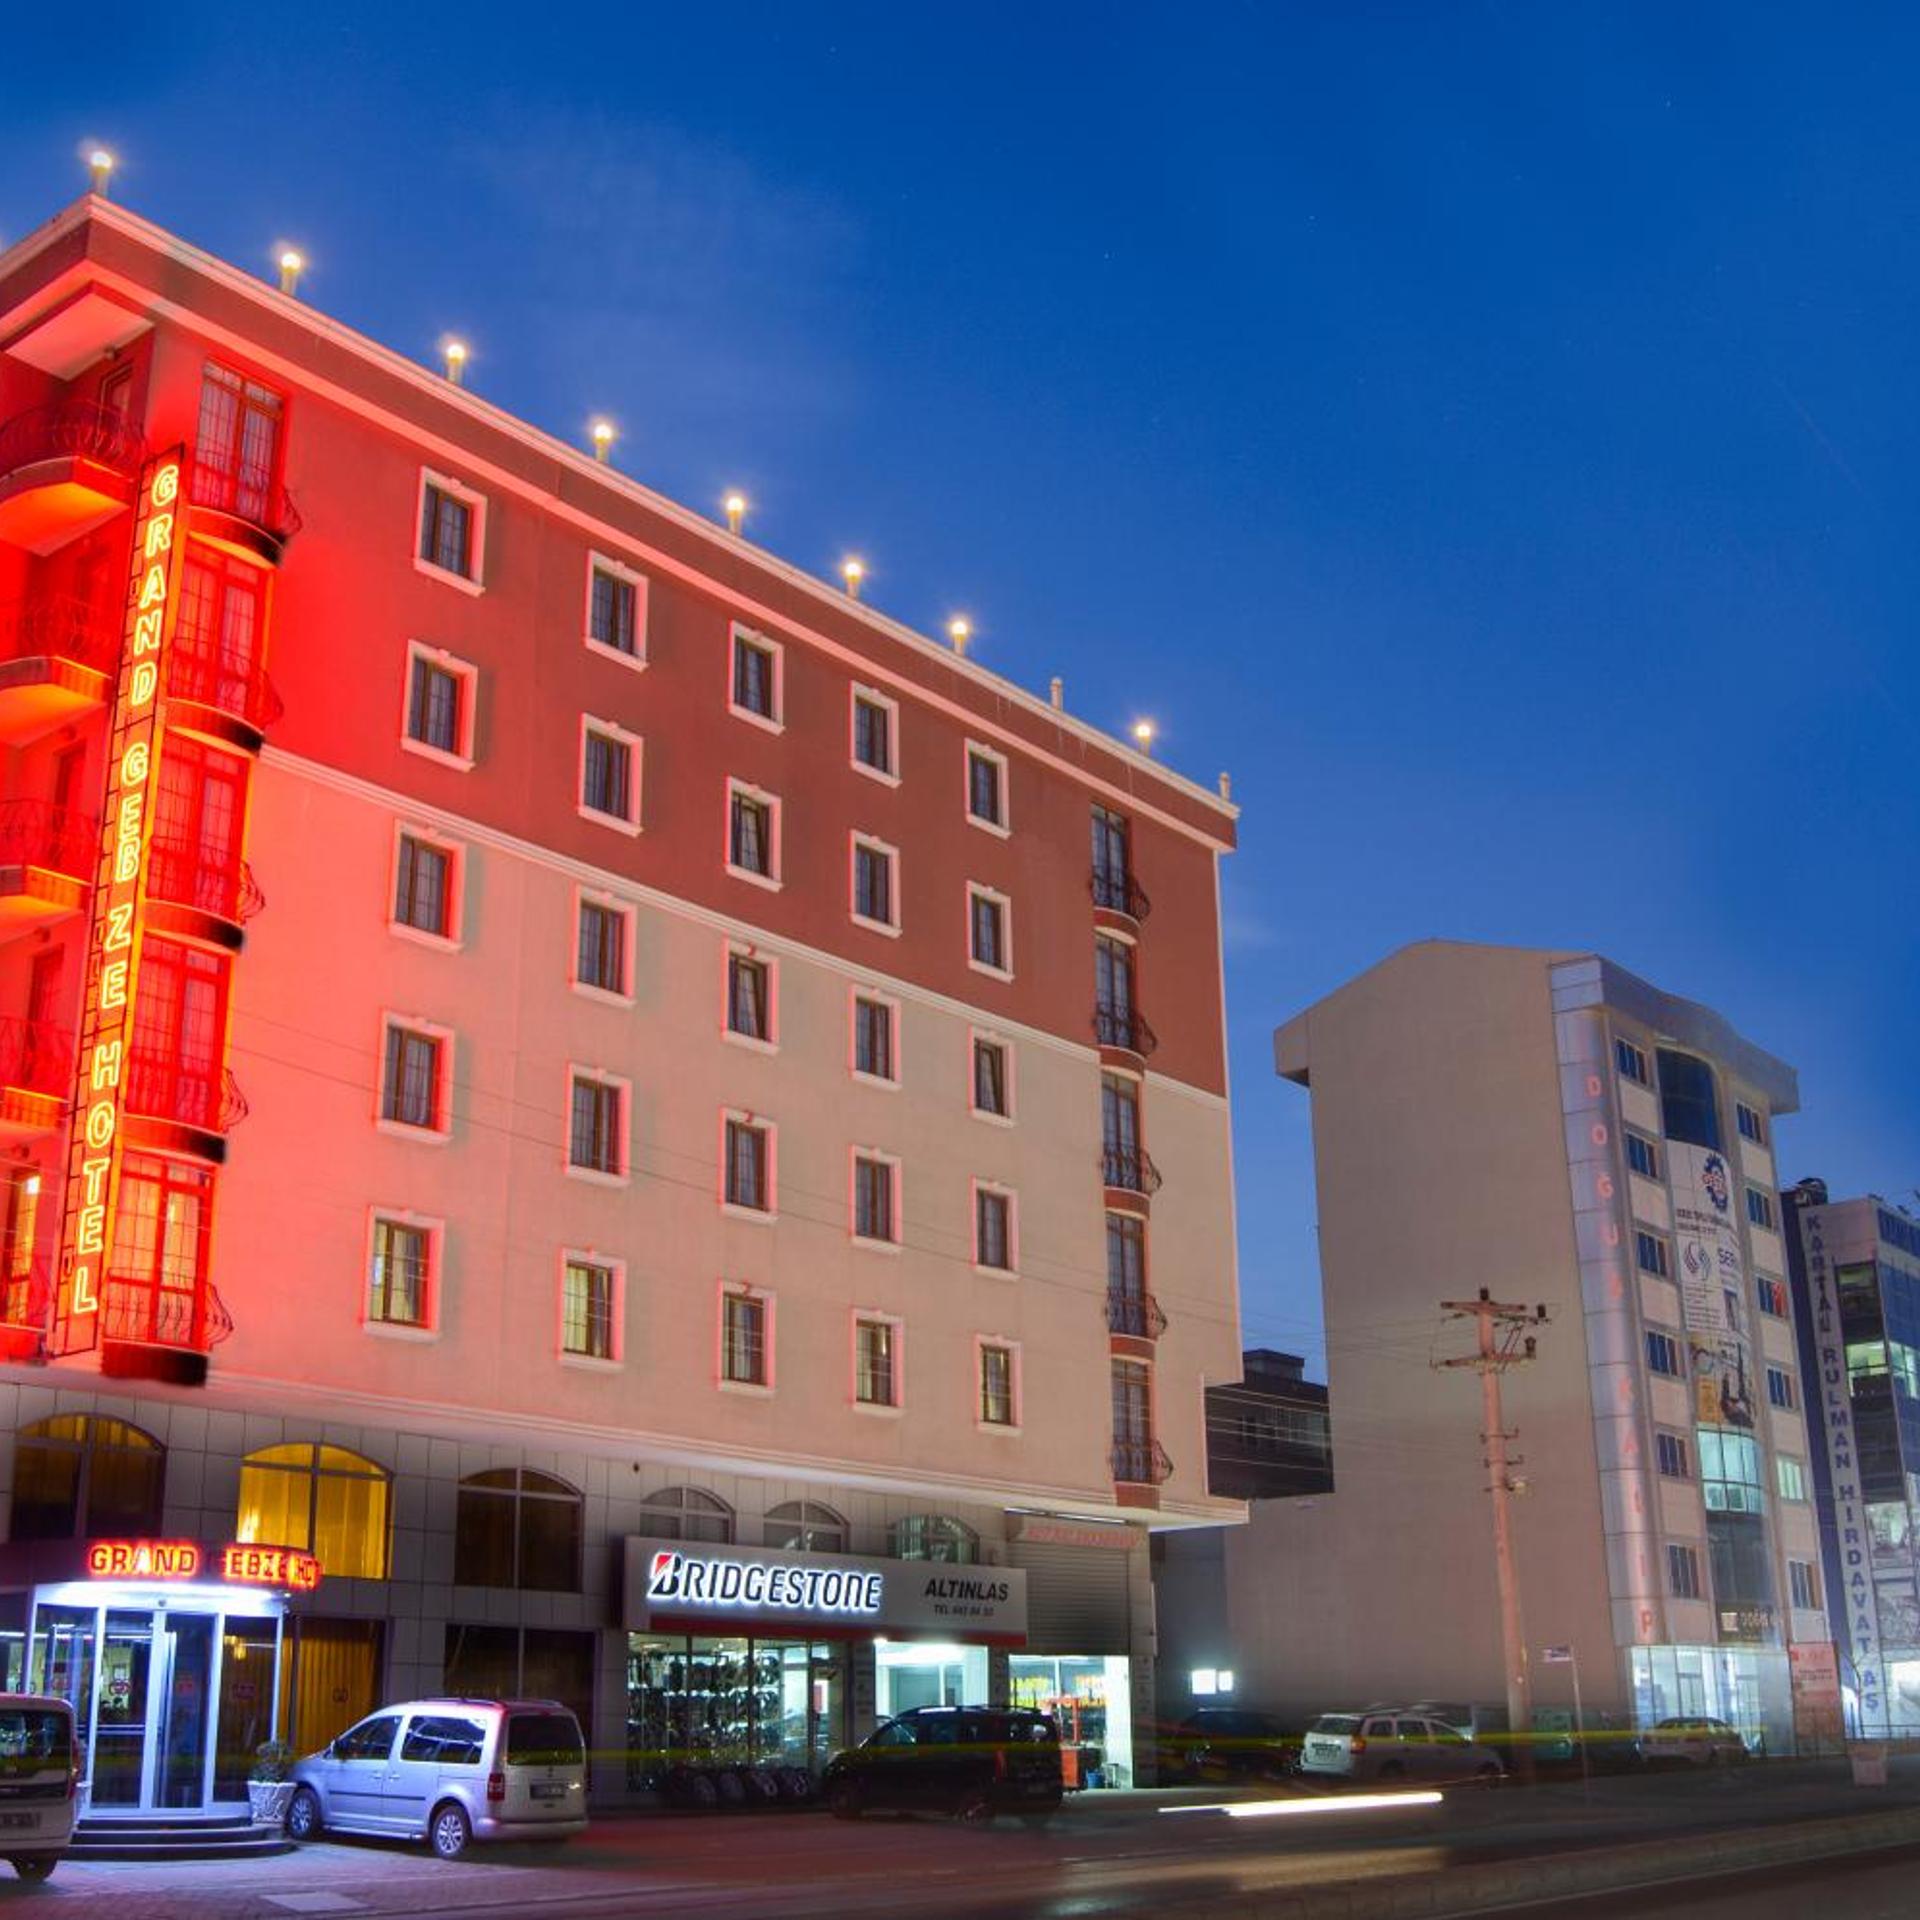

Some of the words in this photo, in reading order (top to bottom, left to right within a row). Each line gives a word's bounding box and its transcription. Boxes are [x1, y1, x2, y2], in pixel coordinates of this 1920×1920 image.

[133, 464, 179, 707] GRAND
[101, 742, 150, 1010] GEBZE
[74, 1039, 122, 1315] HOTEL
[1823, 1348, 1851, 1469] RULMAN
[89, 1545, 197, 1574] GRAND
[650, 1552, 882, 1610] BRIDGESTONE
